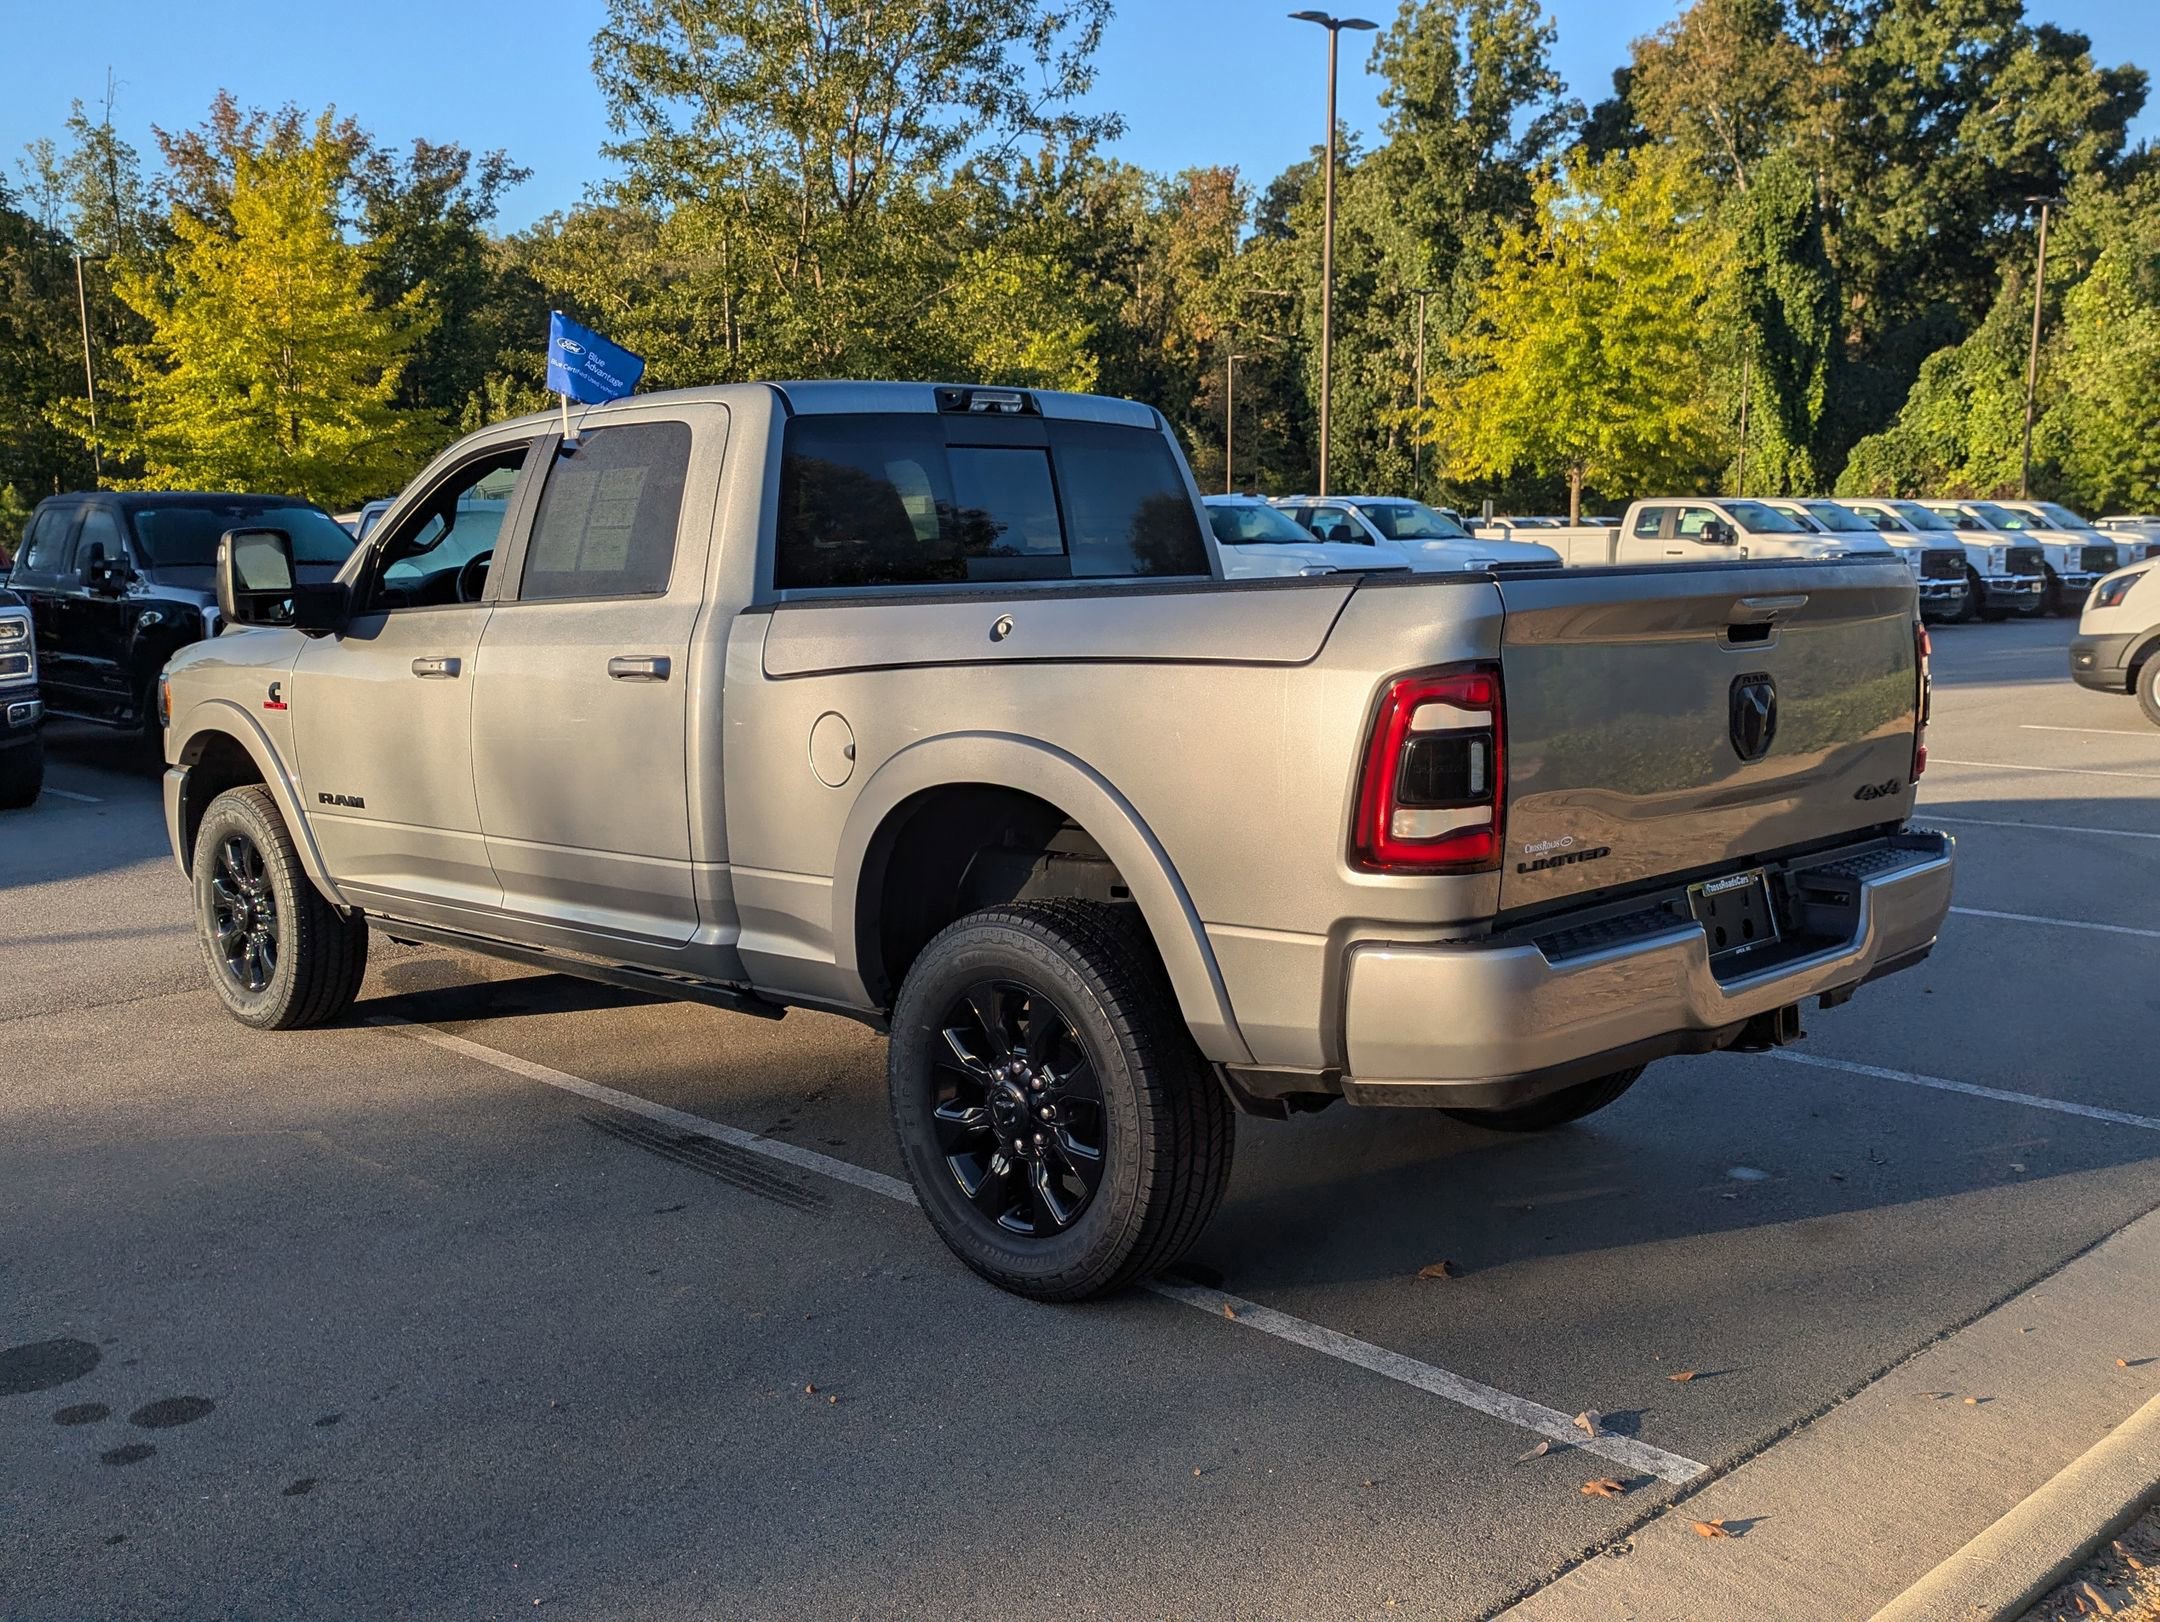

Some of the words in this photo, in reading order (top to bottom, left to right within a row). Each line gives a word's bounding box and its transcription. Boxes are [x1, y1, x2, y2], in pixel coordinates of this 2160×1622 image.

[550, 358, 563, 368] Blue
[588, 351, 606, 368] Blue
[584, 361, 624, 388] Advantage
[318, 792, 366, 809] RAM
[1517, 846, 1612, 874] LIMITED
